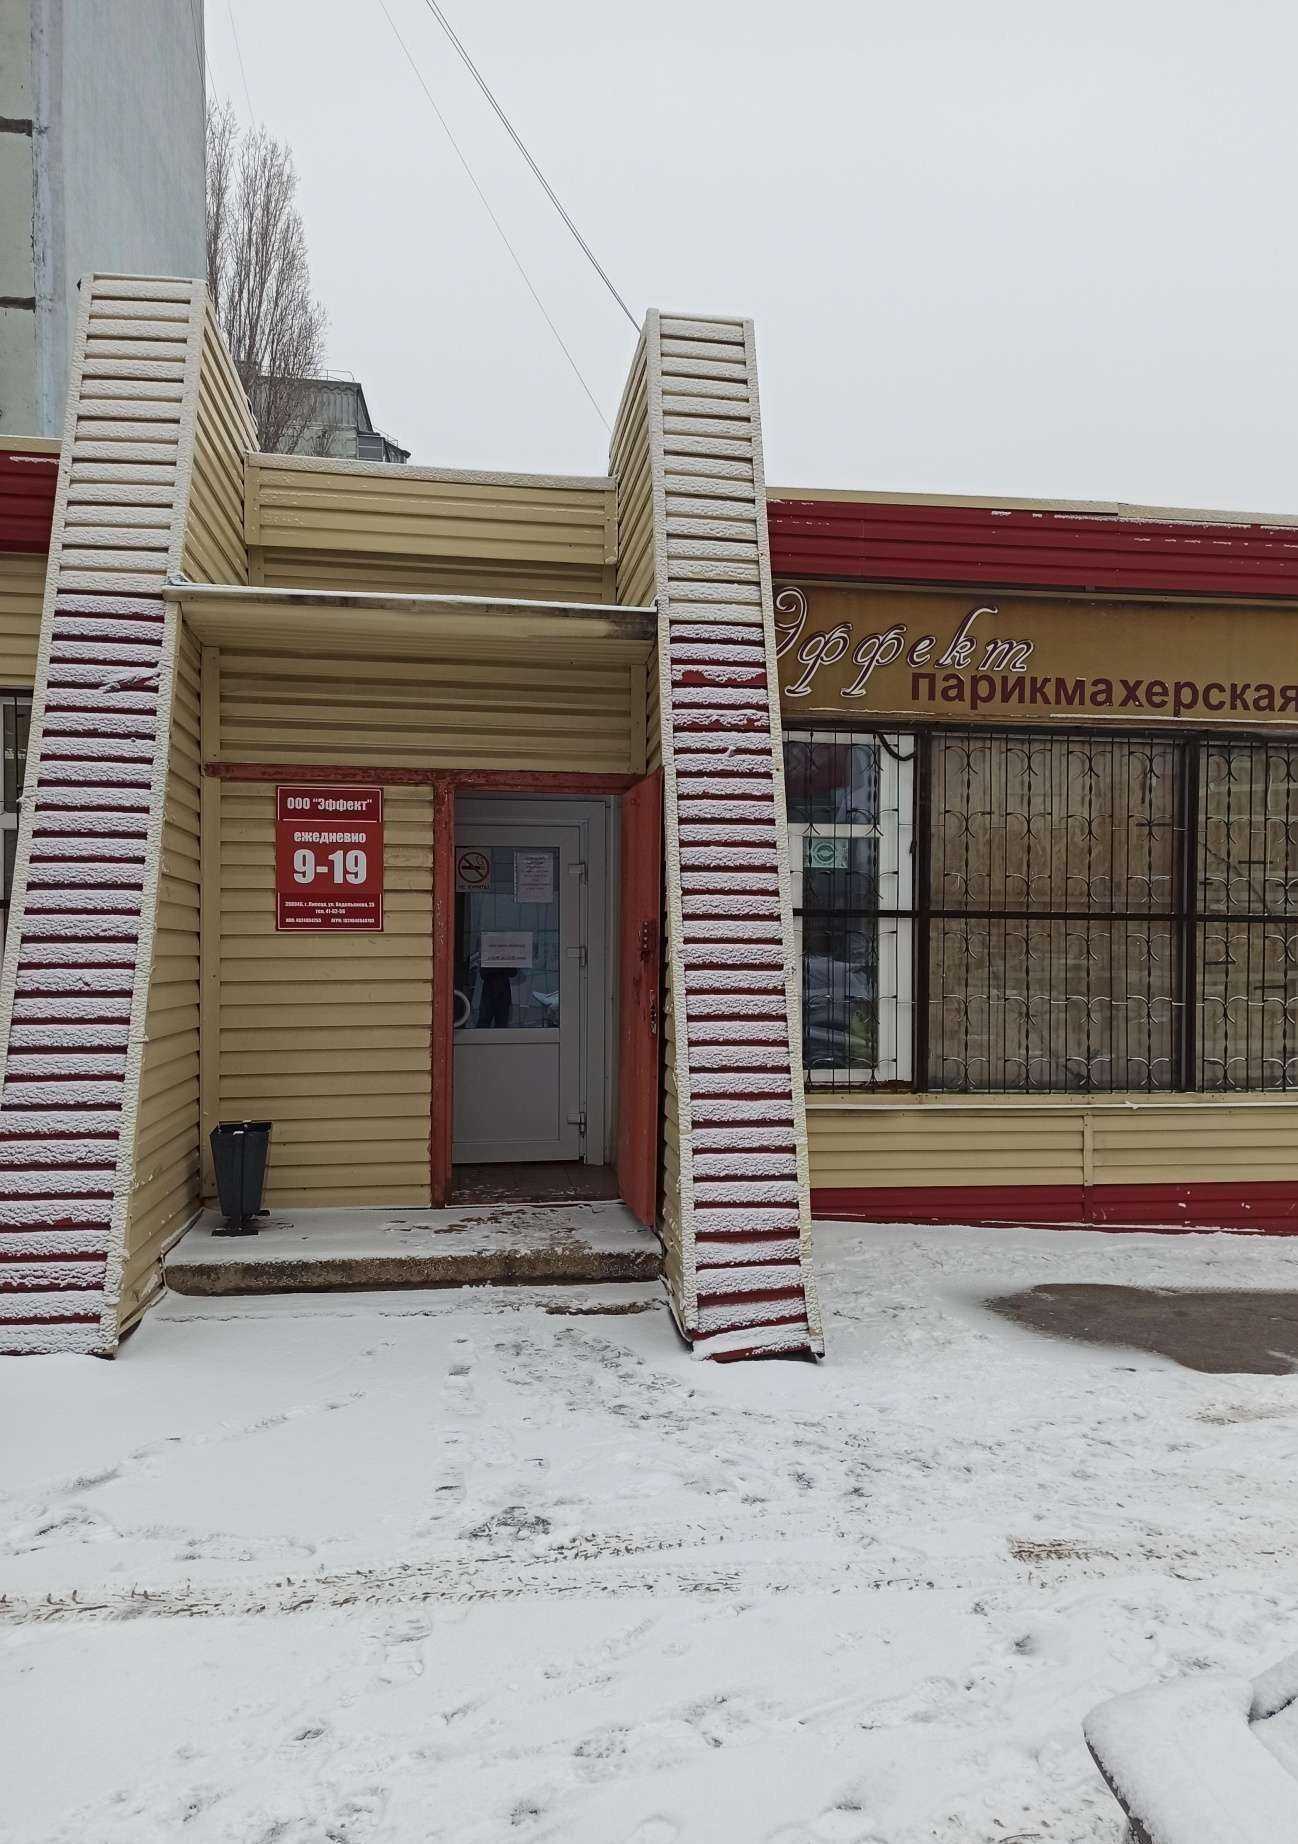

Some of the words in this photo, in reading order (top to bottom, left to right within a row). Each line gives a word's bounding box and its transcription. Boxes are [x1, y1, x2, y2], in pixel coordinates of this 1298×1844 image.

[911, 671, 1298, 718] парикмахерская
[287, 797, 311, 809] ООО
[293, 831, 367, 844] ежедневно
[293, 848, 367, 885] 9-19
